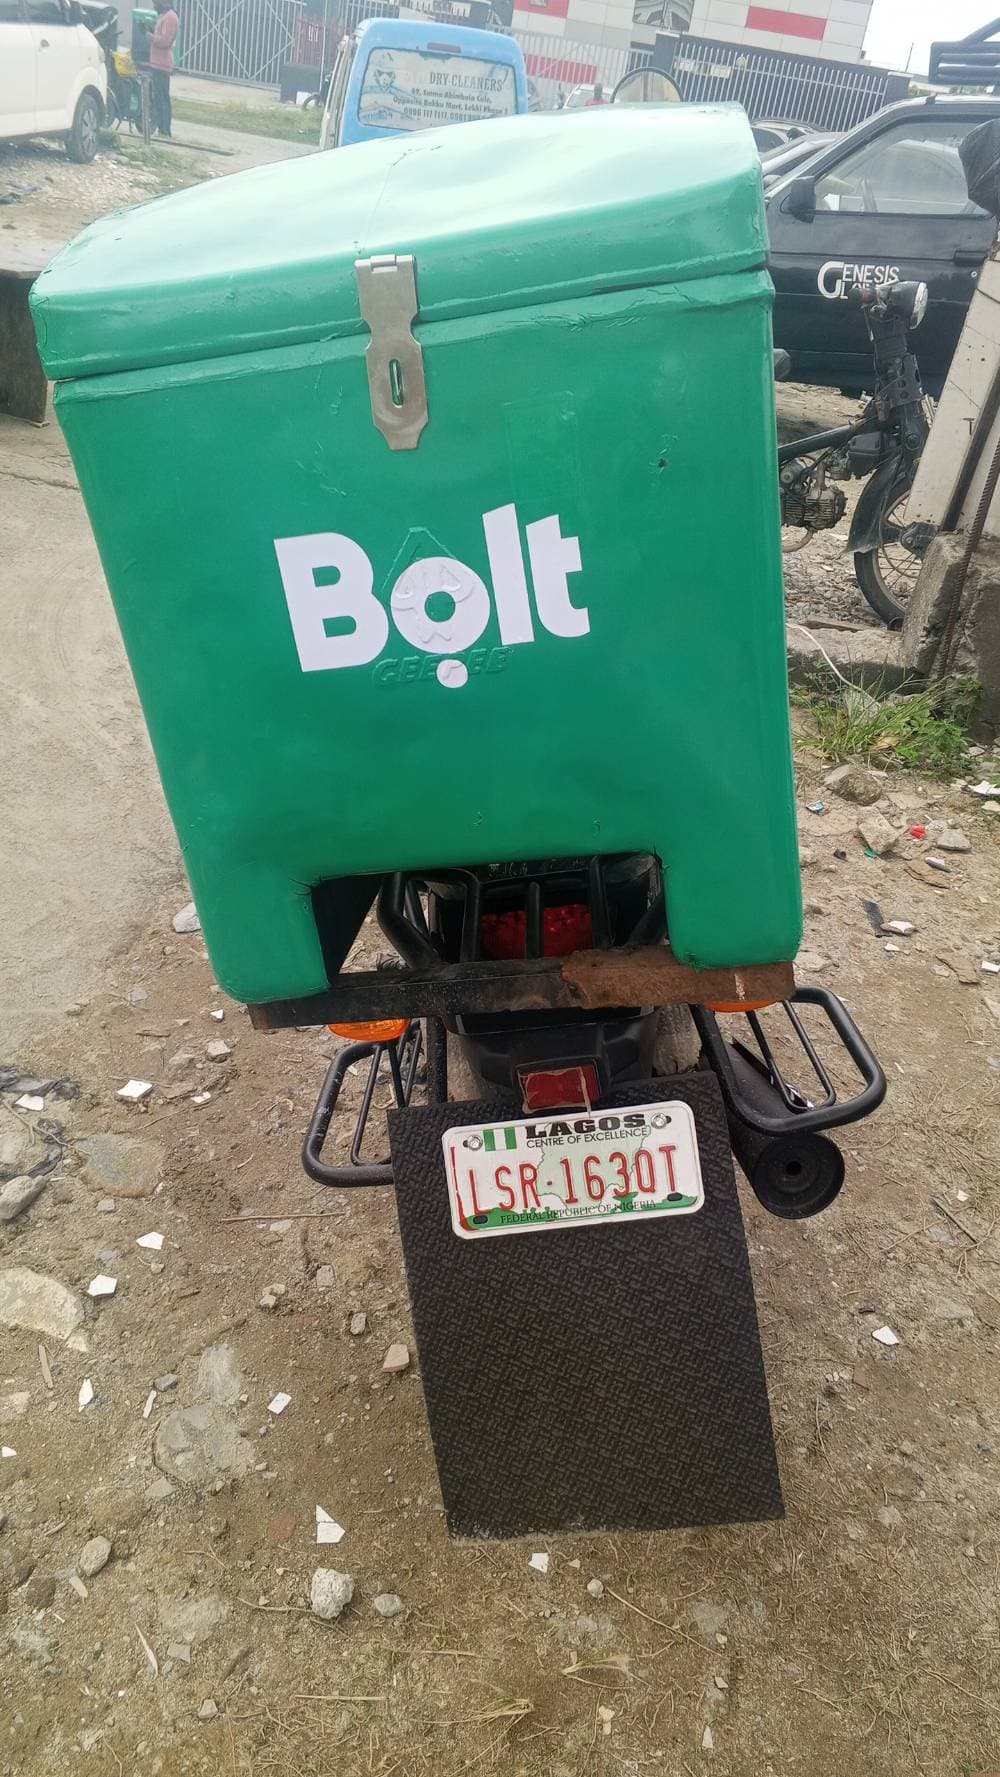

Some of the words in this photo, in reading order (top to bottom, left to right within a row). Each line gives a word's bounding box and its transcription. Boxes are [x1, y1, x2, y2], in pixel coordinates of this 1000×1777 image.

[817, 261, 900, 298] GENESIS
[274, 503, 590, 673] Bolt
[526, 1113, 646, 1139] LAGOS
[527, 1136, 564, 1149] CENTRE
[567, 1134, 582, 1145] OF
[584, 1128, 648, 1143] EXCELLENCE
[501, 1211, 543, 1224] FEDERAL
[545, 1206, 597, 1219] REPUBLIC
[598, 1203, 612, 1214] OF
[614, 1199, 657, 1212] NIGERIA
